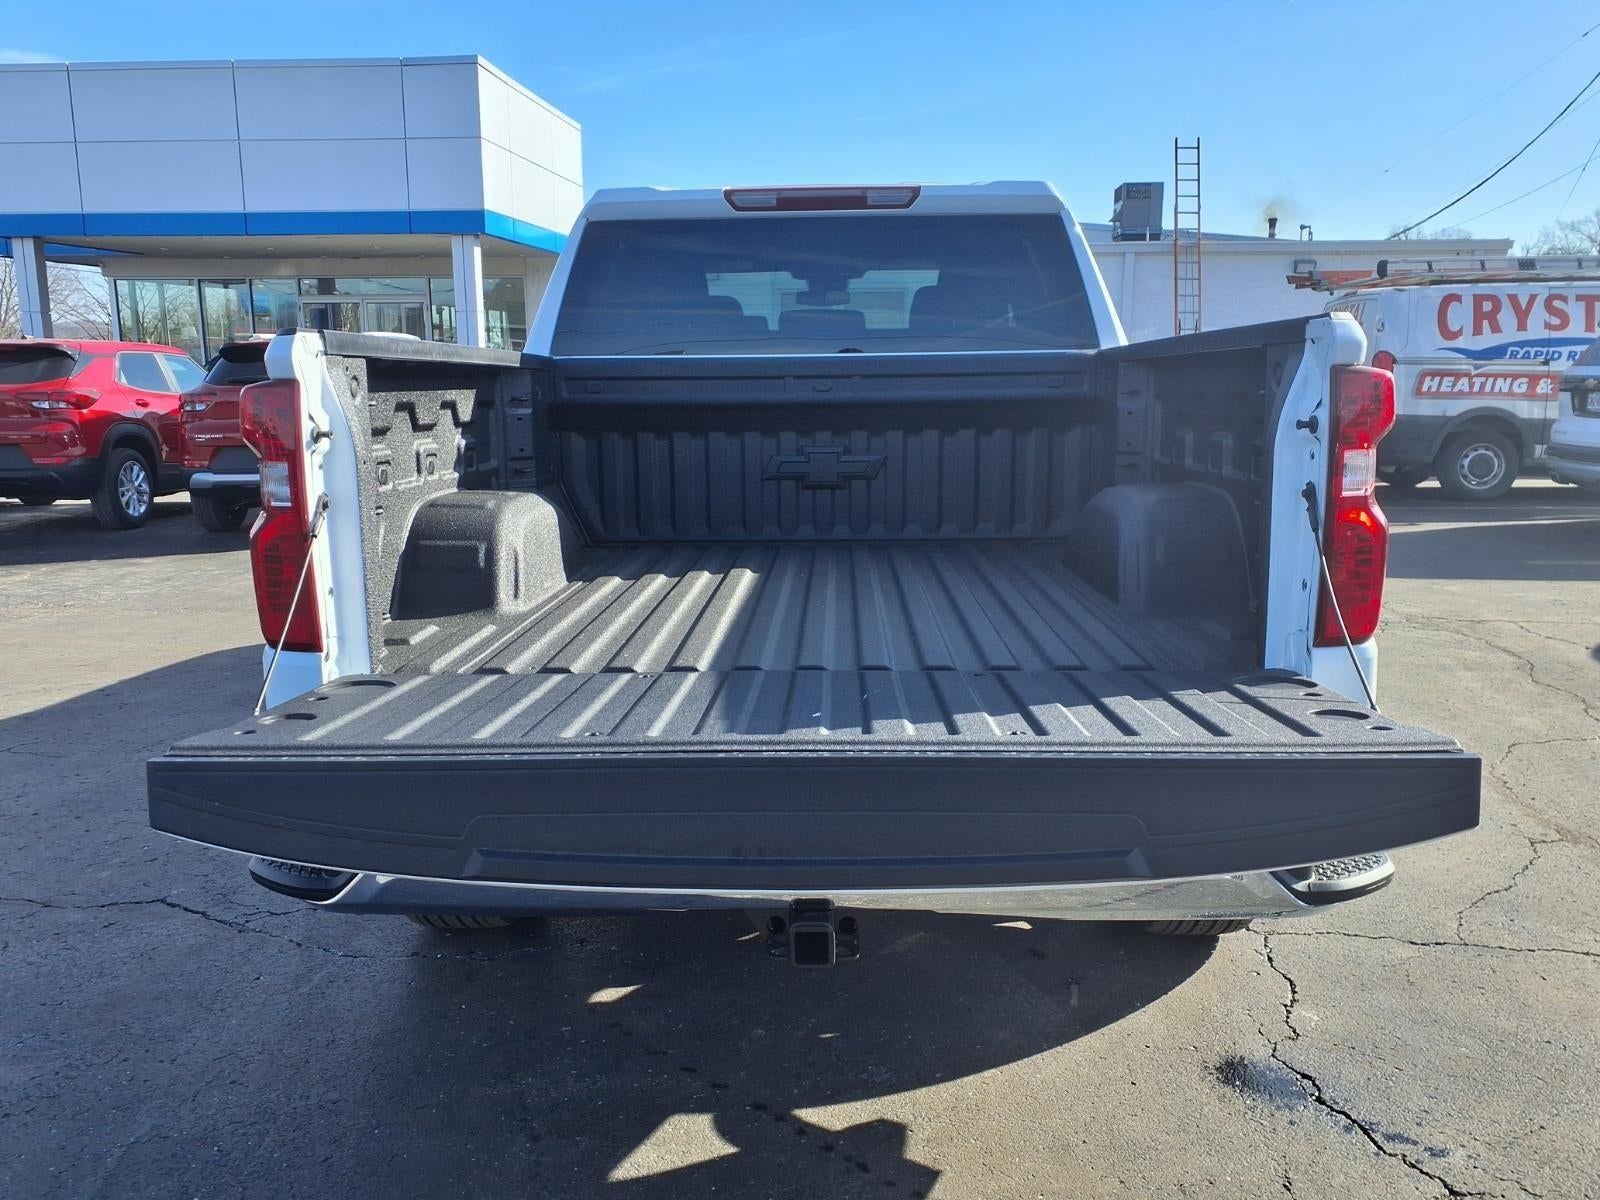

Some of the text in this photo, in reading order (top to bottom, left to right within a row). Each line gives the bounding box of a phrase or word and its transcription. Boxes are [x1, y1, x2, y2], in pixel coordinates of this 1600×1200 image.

[1437, 293, 1600, 341] CRYST
[1507, 348, 1563, 361] RAPID
[1421, 375, 1554, 394] HEATING &
